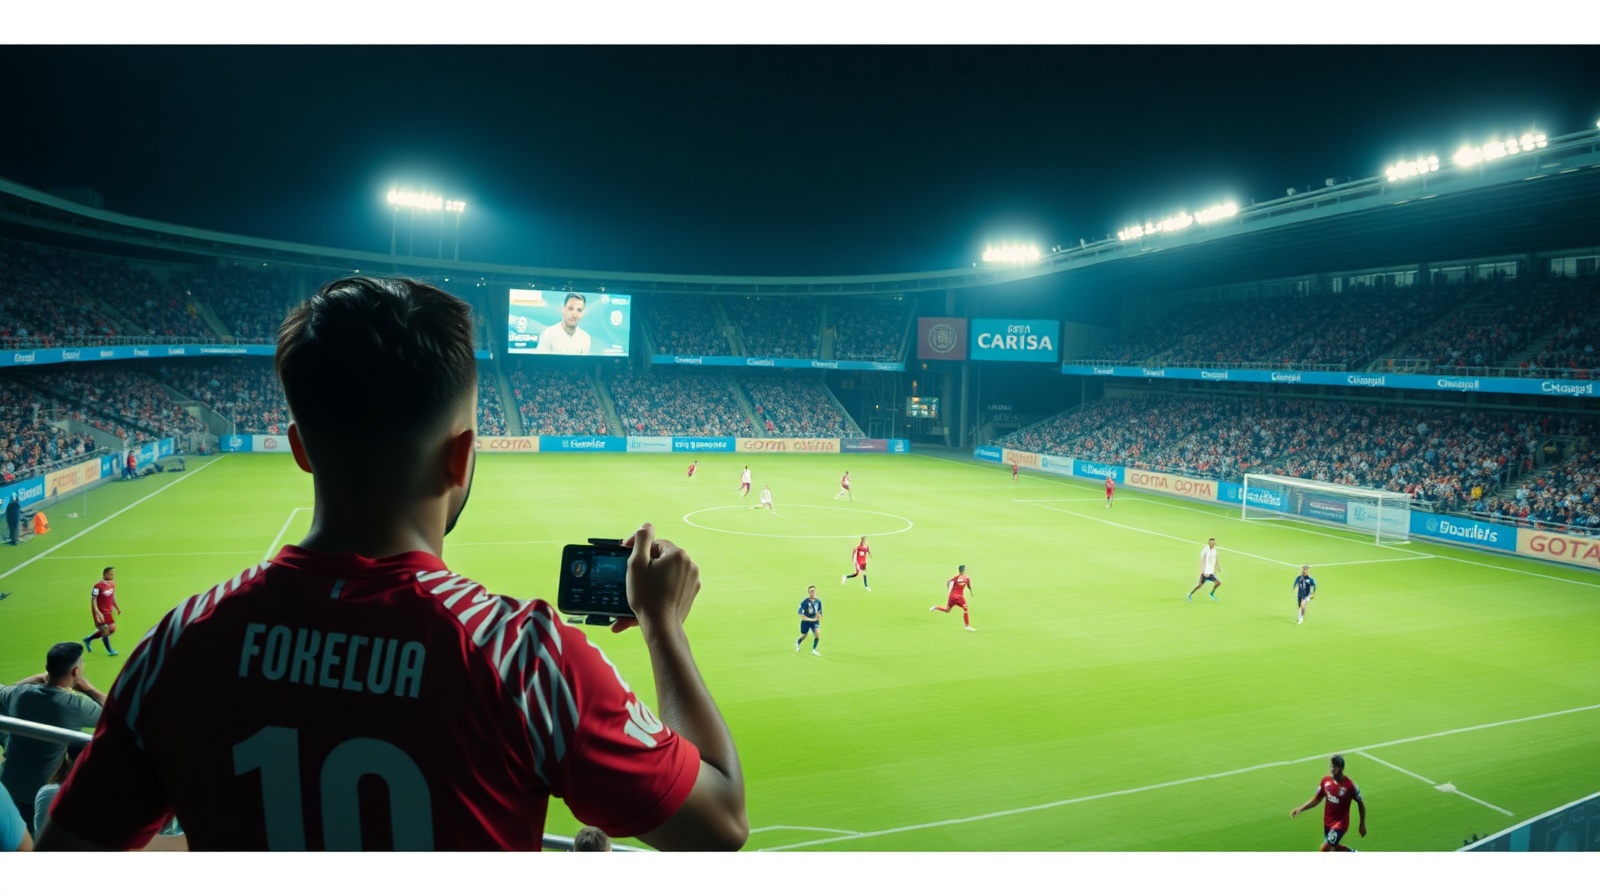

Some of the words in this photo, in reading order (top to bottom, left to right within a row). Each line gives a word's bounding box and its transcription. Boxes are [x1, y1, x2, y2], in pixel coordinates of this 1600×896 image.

[977, 332, 1053, 351] CARISA
[1529, 534, 1600, 561] GOTA
[232, 725, 435, 852] 10
